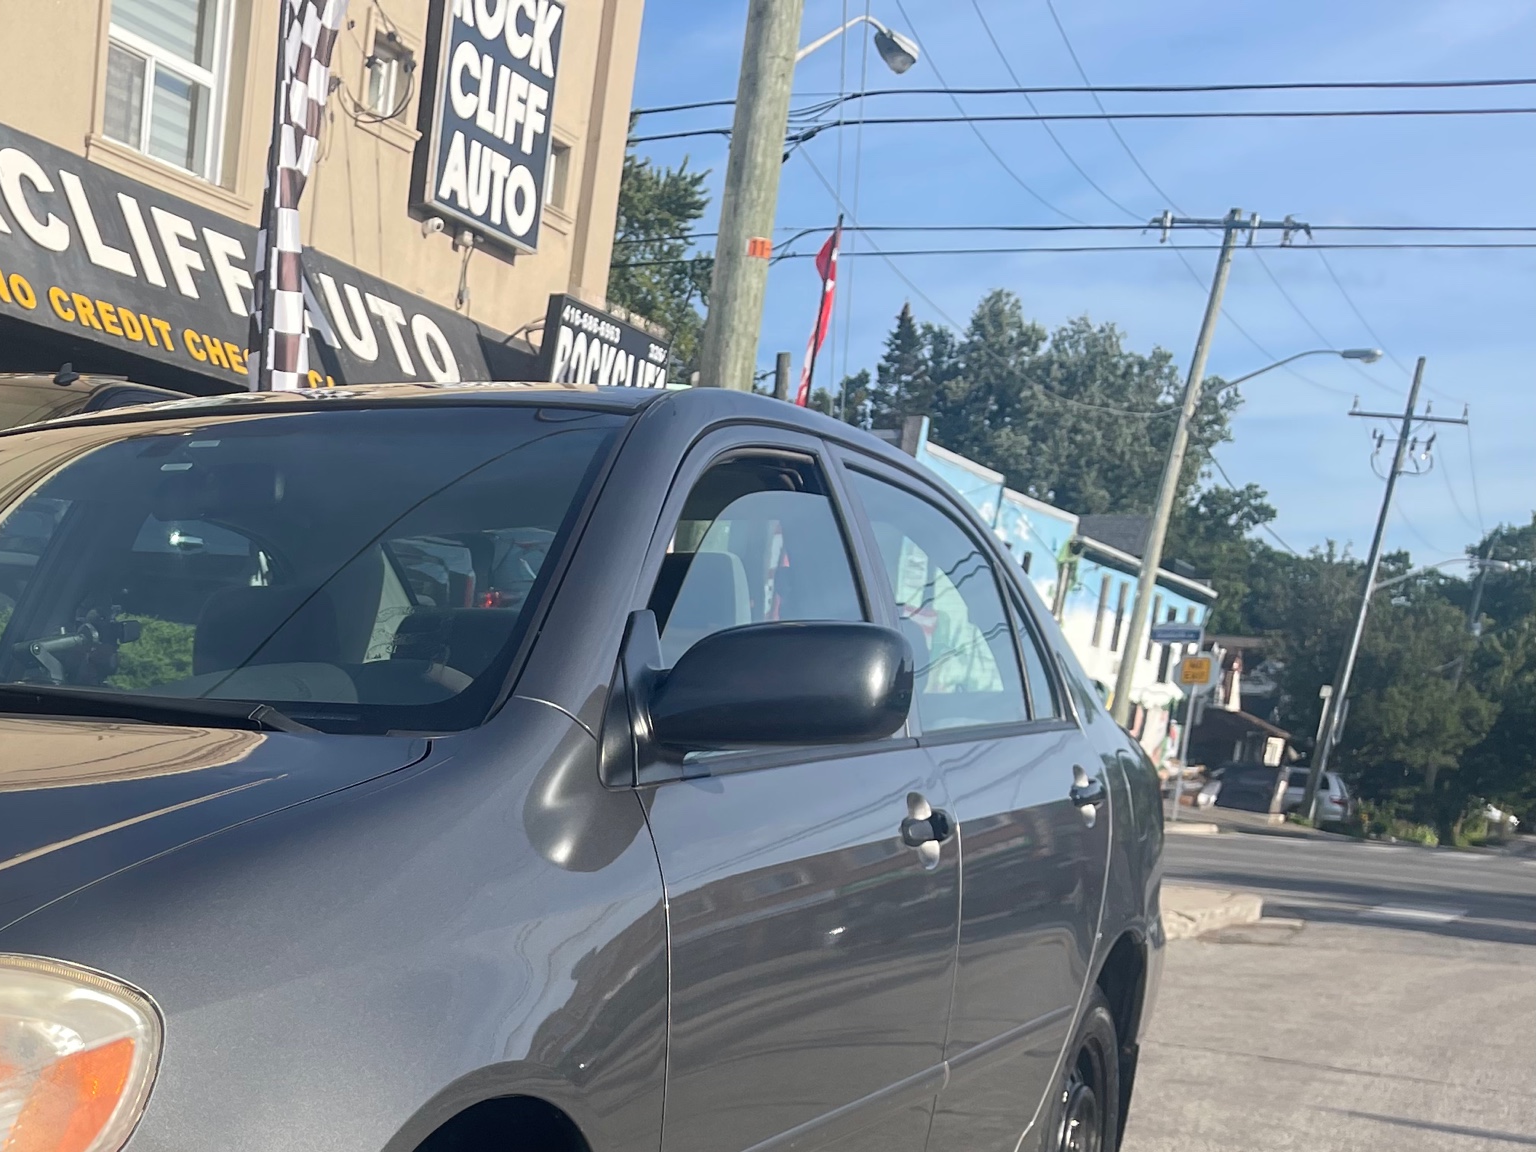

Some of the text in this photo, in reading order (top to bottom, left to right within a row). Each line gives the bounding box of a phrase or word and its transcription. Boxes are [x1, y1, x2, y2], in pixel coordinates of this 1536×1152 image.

[449, 40, 550, 156] CLIFF
[438, 130, 539, 238] AUTO
[49, 286, 175, 352] CREDIT
